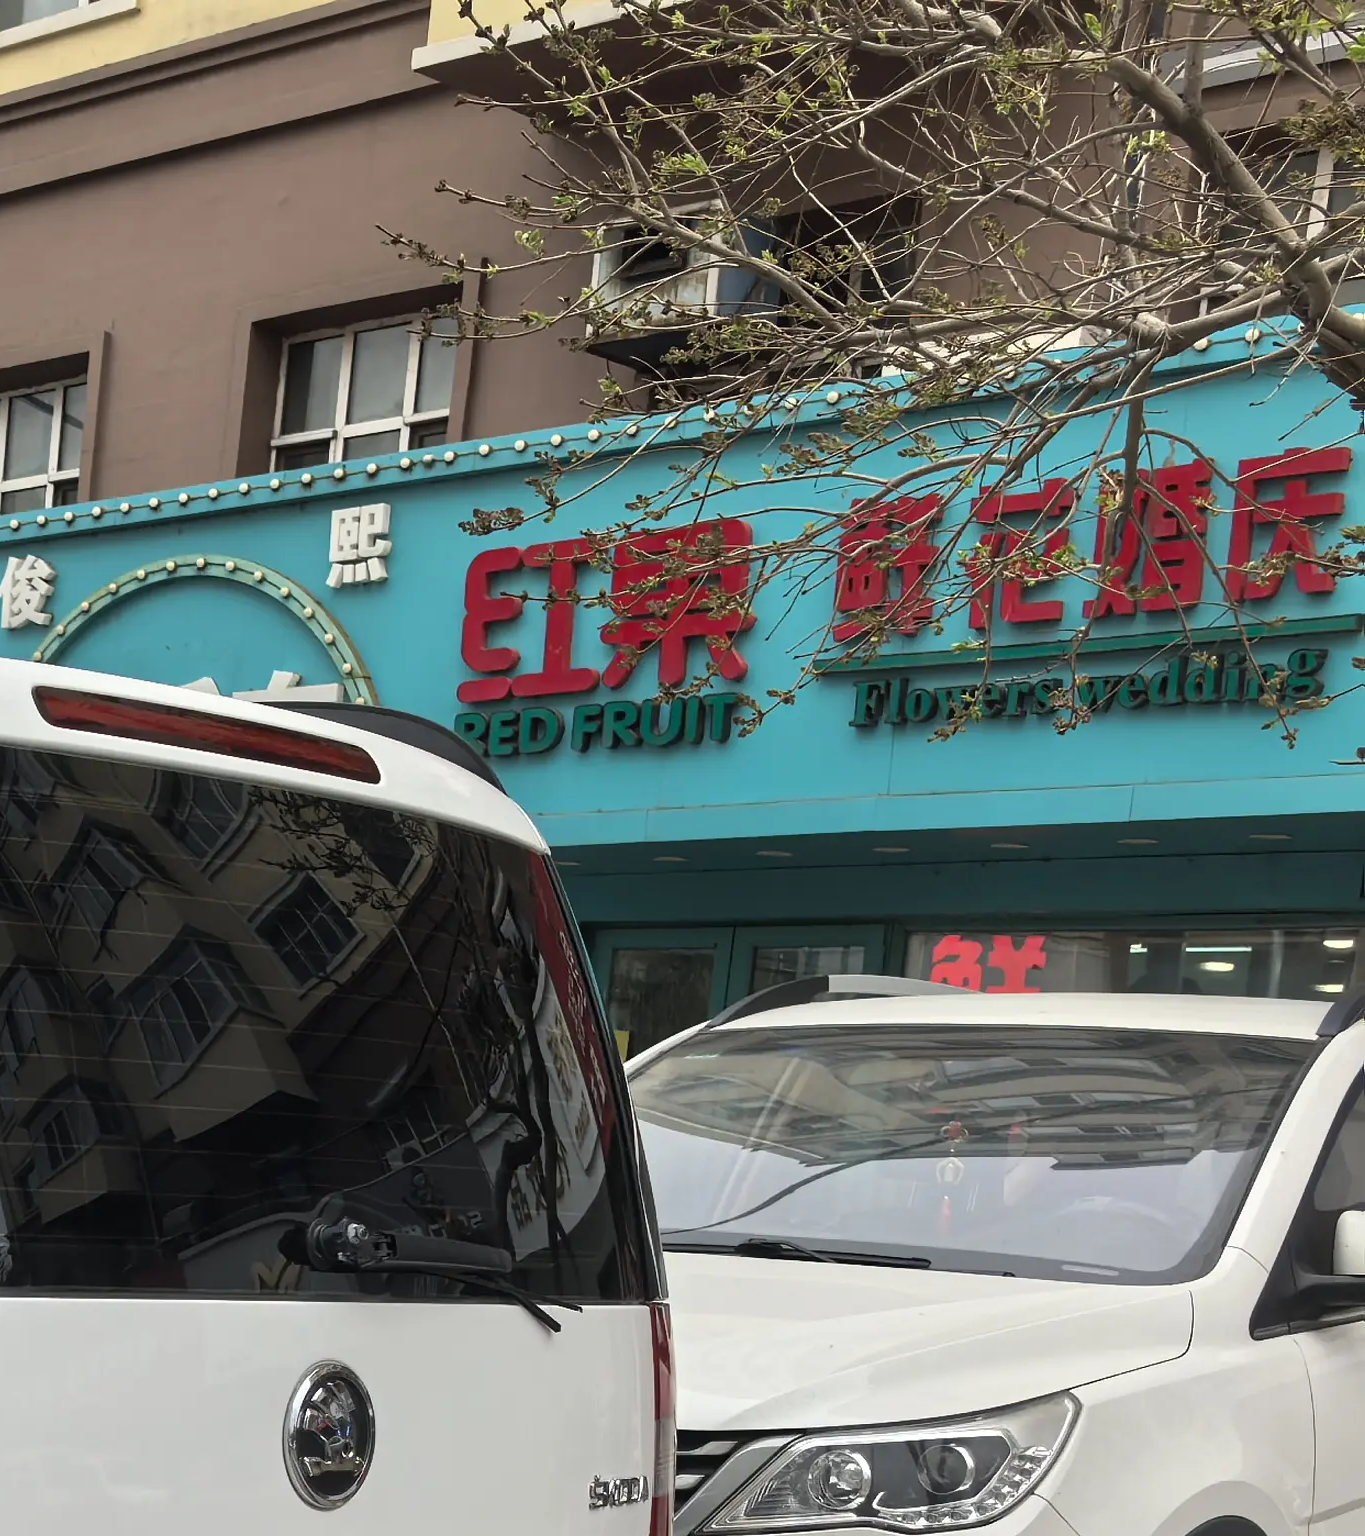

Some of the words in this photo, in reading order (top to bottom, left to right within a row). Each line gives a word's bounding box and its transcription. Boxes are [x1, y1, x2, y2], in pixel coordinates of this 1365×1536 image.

[326, 502, 392, 589] 熙
[832, 446, 1353, 643] 鲜花婚庆
[456, 518, 758, 703] 红果
[454, 705, 566, 758] RED
[570, 691, 745, 755] FRUIT
[849, 676, 1065, 728] Flowers
[1073, 646, 1329, 714] wedding
